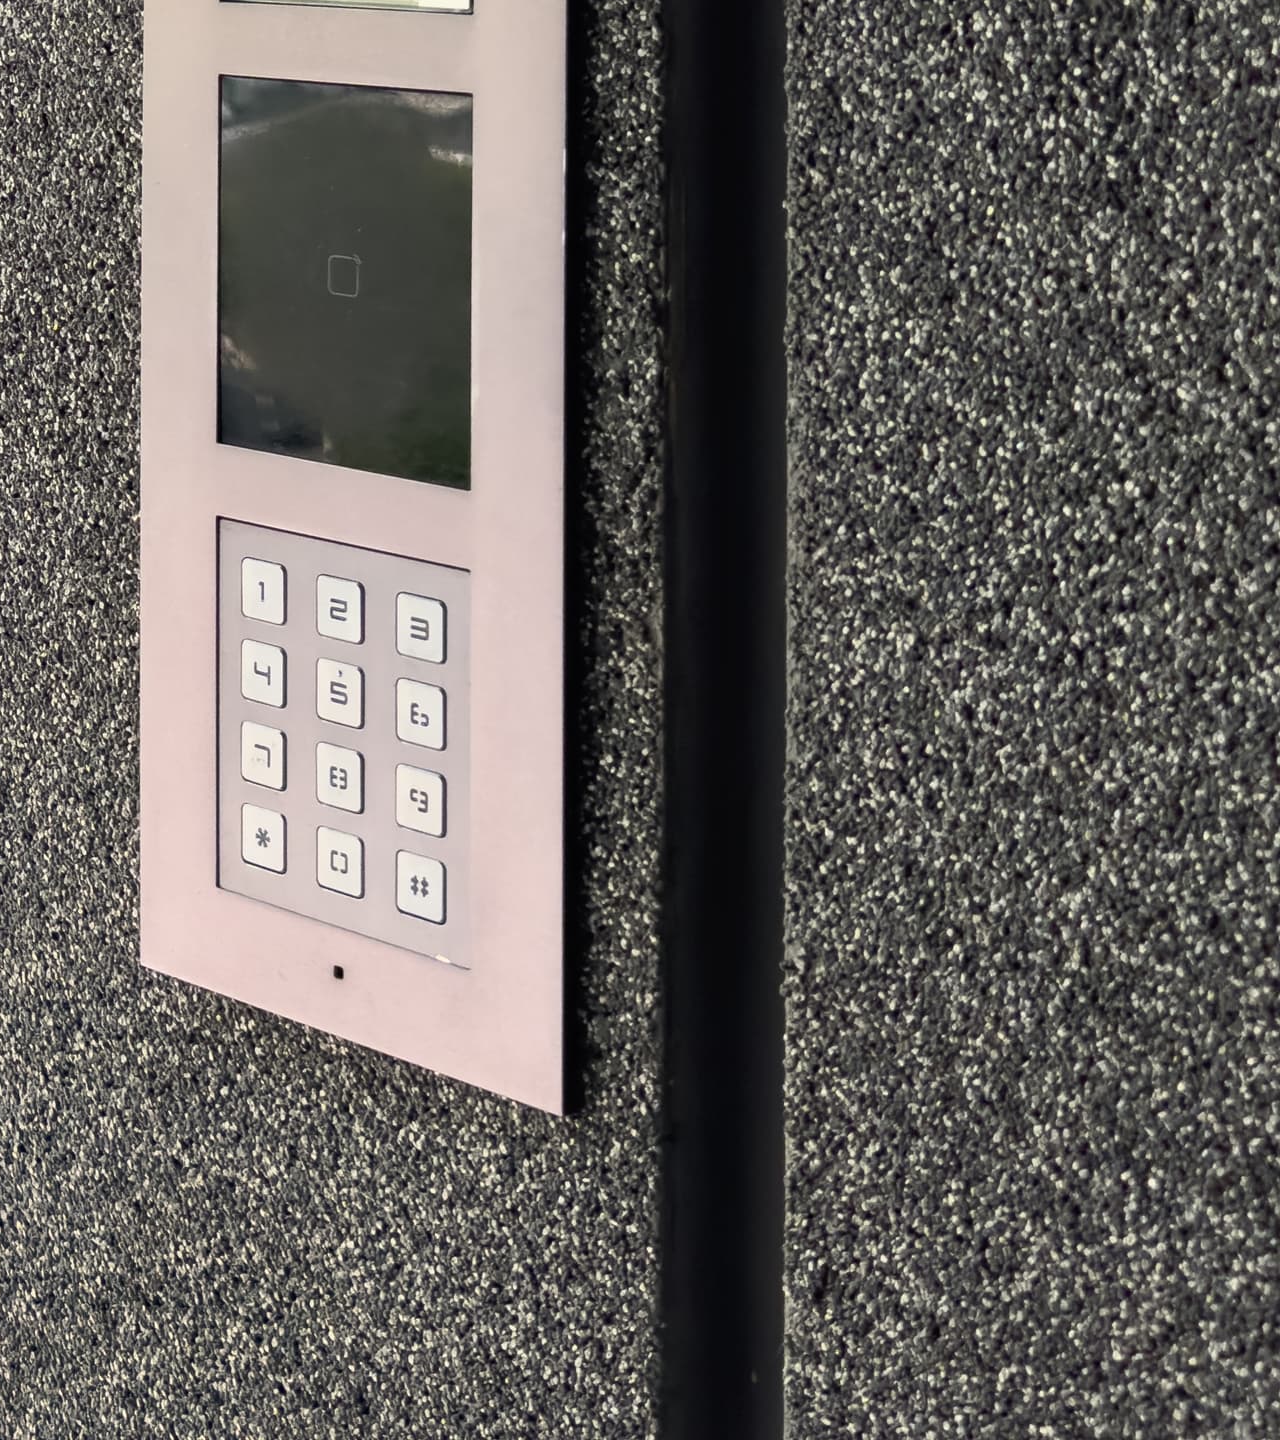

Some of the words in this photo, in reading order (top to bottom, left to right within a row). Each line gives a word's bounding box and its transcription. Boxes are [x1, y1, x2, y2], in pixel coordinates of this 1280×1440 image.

[258, 581, 265, 602] 1
[329, 598, 348, 622] 2
[410, 616, 430, 641] 3
[253, 661, 271, 686] 4
[330, 681, 348, 706] 5
[410, 702, 430, 727] 6
[254, 743, 271, 768] 7
[329, 766, 348, 790] 8
[409, 788, 429, 814] 9
[330, 850, 348, 874] 0
